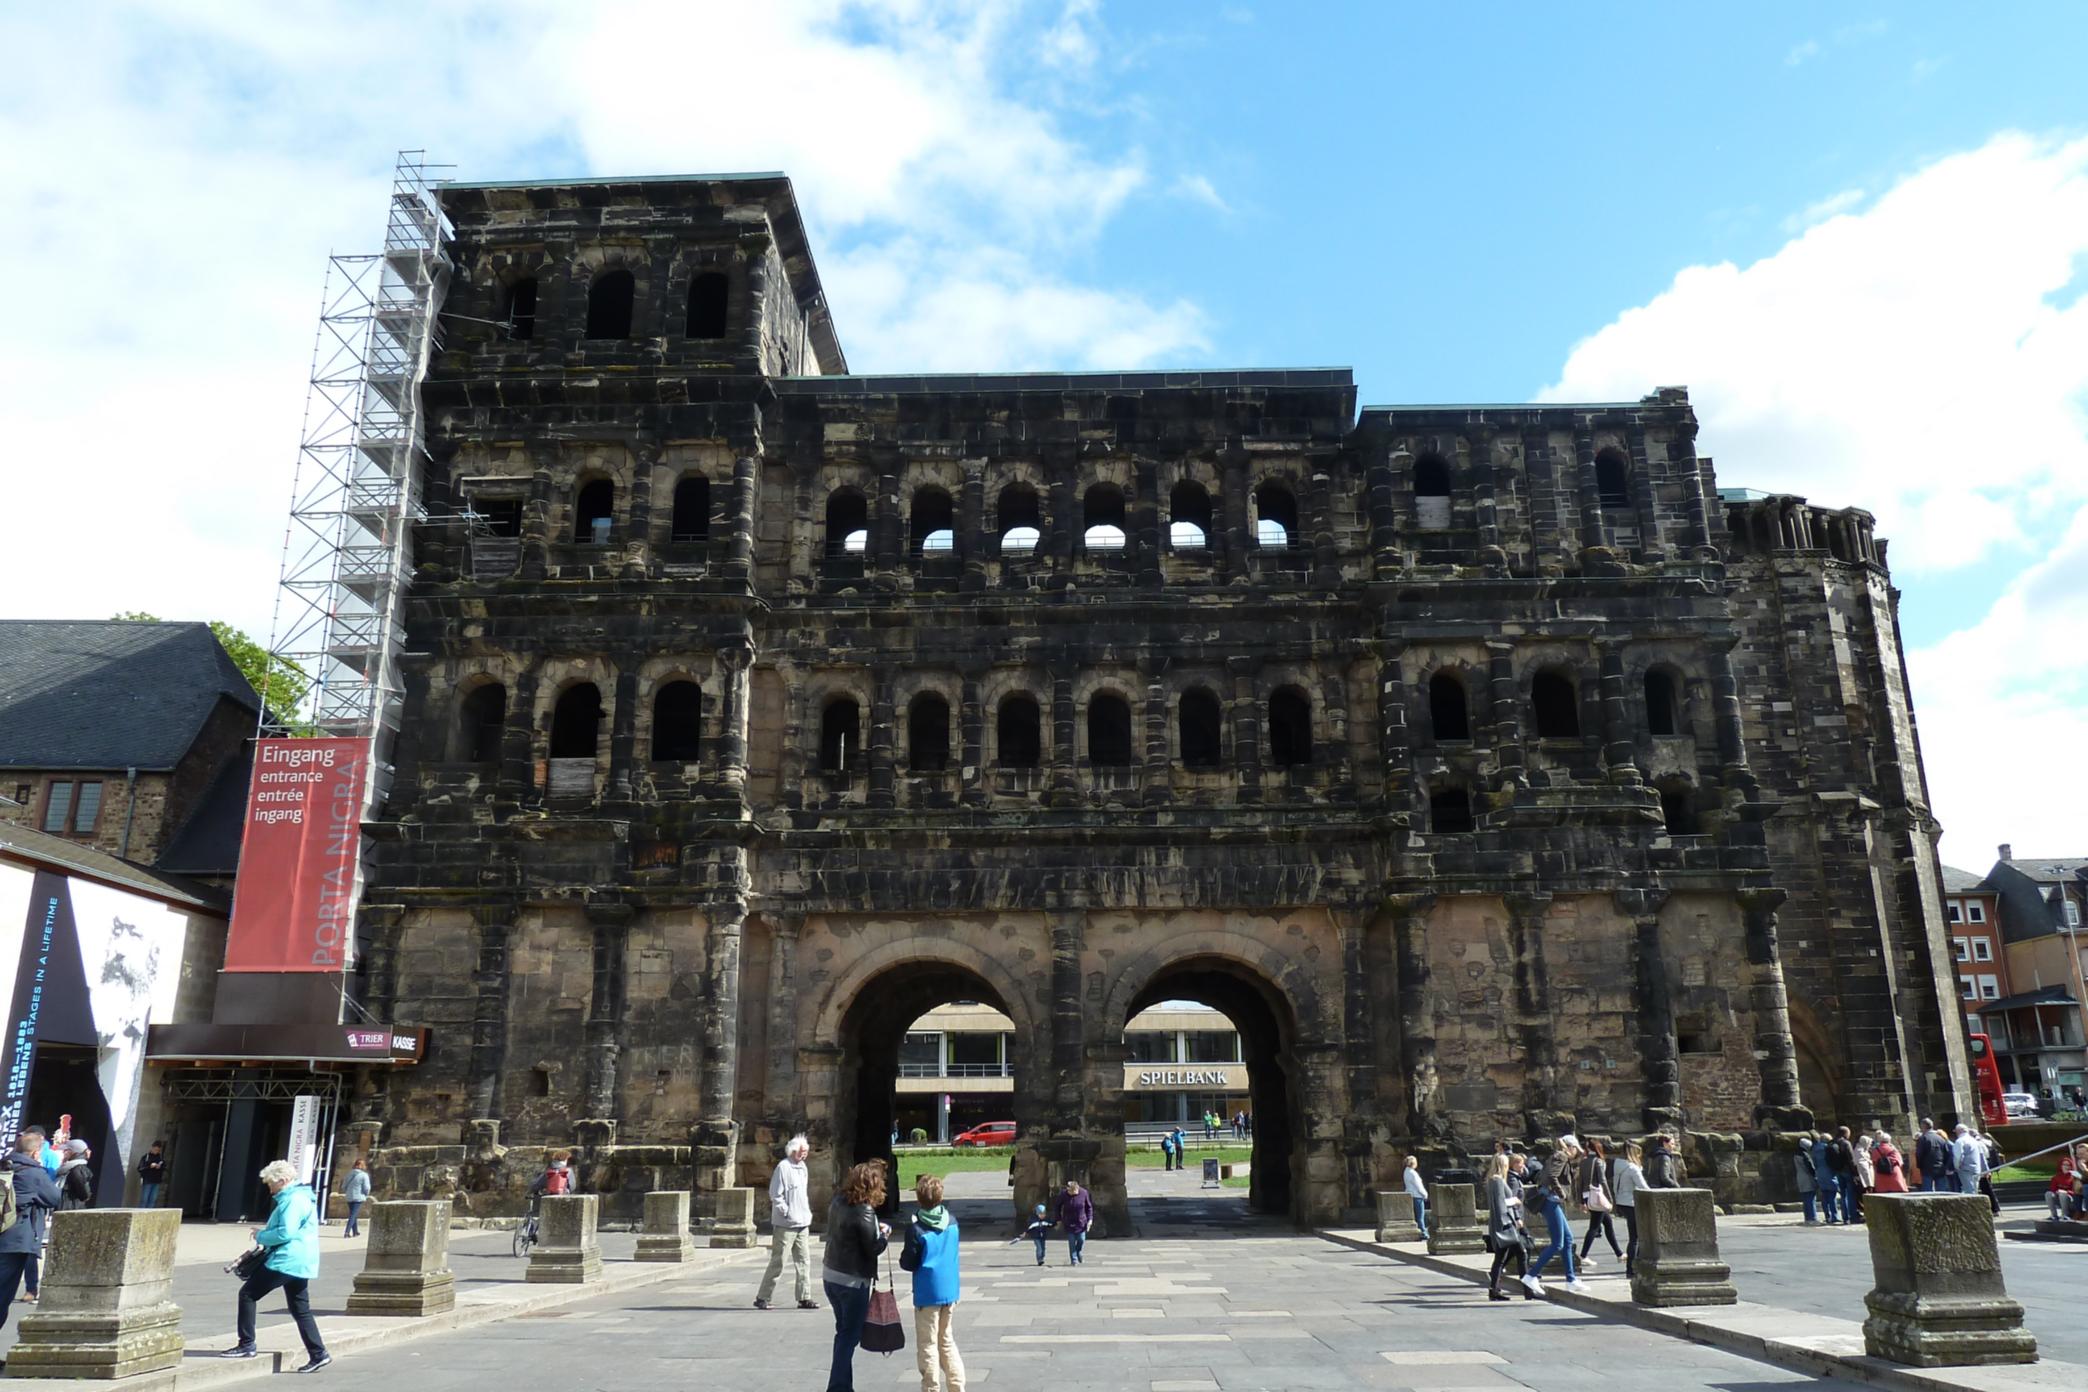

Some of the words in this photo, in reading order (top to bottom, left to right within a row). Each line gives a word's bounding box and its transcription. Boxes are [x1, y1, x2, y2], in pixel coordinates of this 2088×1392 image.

[262, 746, 336, 767] Eingang
[260, 771, 324, 783] entrance
[257, 788, 304, 802] entrée
[255, 808, 303, 824] ingang
[326, 759, 361, 856] NIGRA
[41, 897, 58, 952] LIFETIME
[311, 866, 347, 965] PORTA
[39, 956, 48, 965] A
[36, 969, 45, 982] IN
[27, 986, 42, 1035] STAGES
[360, 1034, 384, 1044] TRIER
[392, 1035, 416, 1051] KASSE
[16, 1042, 32, 1096] LEBENS
[1140, 1071, 1227, 1085] SPIELBANK
[7, 1100, 22, 1143] EINES
[298, 1100, 307, 1124] KASSE
[295, 1128, 303, 1154] NIGRA
